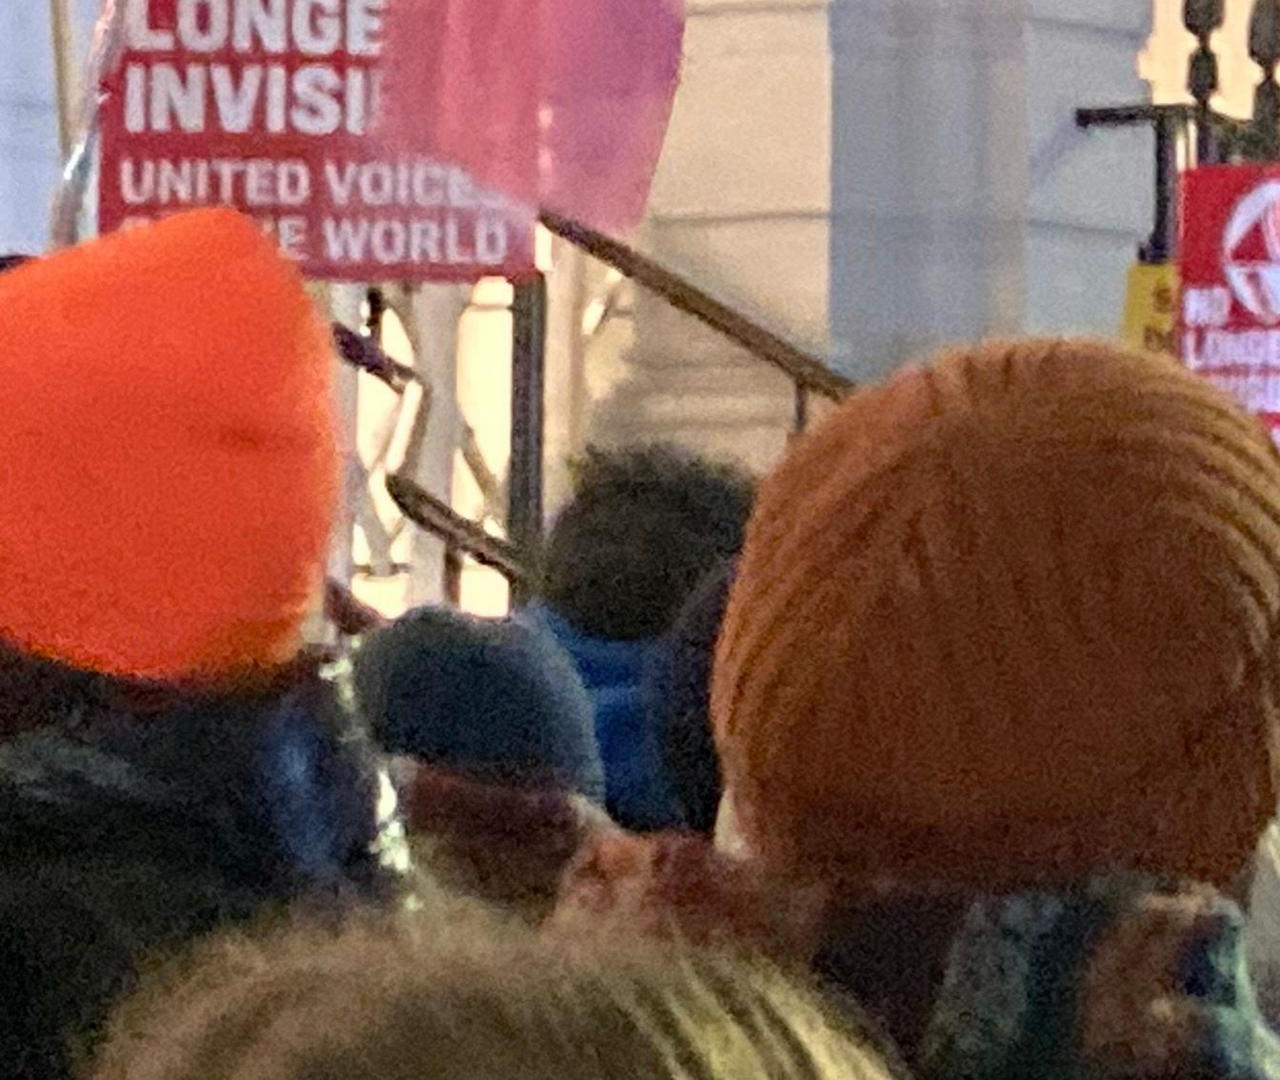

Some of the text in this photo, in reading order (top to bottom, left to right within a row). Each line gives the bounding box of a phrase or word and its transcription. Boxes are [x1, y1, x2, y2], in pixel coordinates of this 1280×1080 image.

[124, 61, 372, 136] INVISI
[120, 158, 310, 206] UNITED
[322, 219, 507, 264] WORLD
